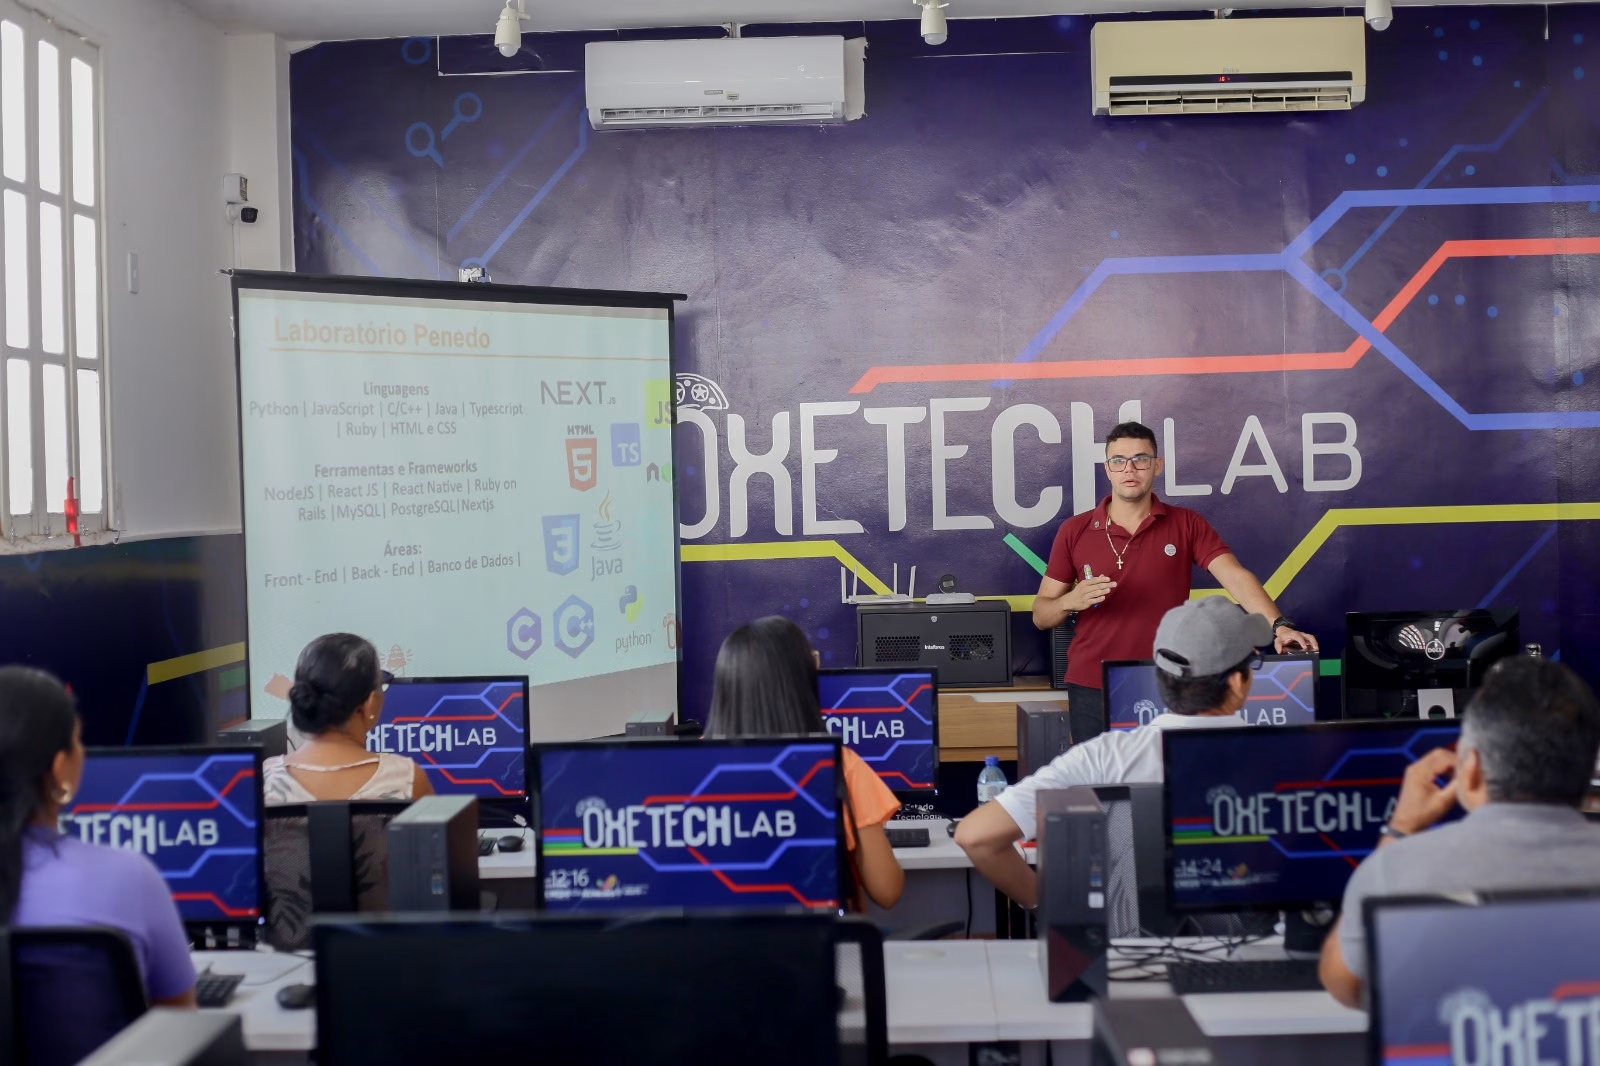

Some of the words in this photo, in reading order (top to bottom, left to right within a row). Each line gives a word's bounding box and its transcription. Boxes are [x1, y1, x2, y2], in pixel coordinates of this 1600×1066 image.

[274, 317, 407, 346] Laboratório
[413, 324, 490, 349] Penedo
[363, 381, 430, 398] Linguagens
[249, 401, 299, 418] Python
[311, 401, 374, 418] JavaScript
[387, 402, 422, 418] C/C++
[435, 403, 458, 416] Java
[469, 402, 524, 419] Typescript
[346, 422, 377, 438] Ruby
[391, 422, 424, 435] HTML
[427, 425, 434, 435] e
[437, 421, 457, 435] CSS
[567, 424, 595, 436] HTML
[618, 442, 640, 463] TS
[1163, 412, 1363, 497] LAB
[314, 462, 394, 478] Ferramentas
[398, 464, 405, 475] e
[408, 459, 478, 475] Frameworks
[571, 447, 592, 482] 5
[264, 484, 314, 501] NodeJS
[328, 484, 363, 498] React
[366, 483, 379, 497] JS
[392, 481, 424, 496] React
[427, 480, 463, 494] Native
[474, 478, 501, 492] Ruby
[504, 479, 517, 490] on
[298, 505, 326, 521] Rails
[383, 540, 422, 557] Áreas:
[264, 572, 303, 588] Front
[315, 568, 337, 584] End
[352, 565, 381, 581] Back
[392, 561, 415, 577] End
[428, 558, 462, 574] Banco
[465, 556, 478, 570] de
[481, 553, 514, 569] Dados
[591, 556, 623, 582] Java
[511, 615, 536, 652] C
[616, 631, 652, 653] python
[1244, 707, 1287, 726] LAB
[366, 723, 453, 752] XETECH
[454, 727, 497, 746] LAB
[861, 719, 905, 739] LAB
[1213, 790, 1362, 836] OXETECH
[1365, 795, 1400, 822] LA
[158, 818, 219, 846] LAB
[583, 804, 731, 849] OXETECH
[734, 810, 797, 838] LAB
